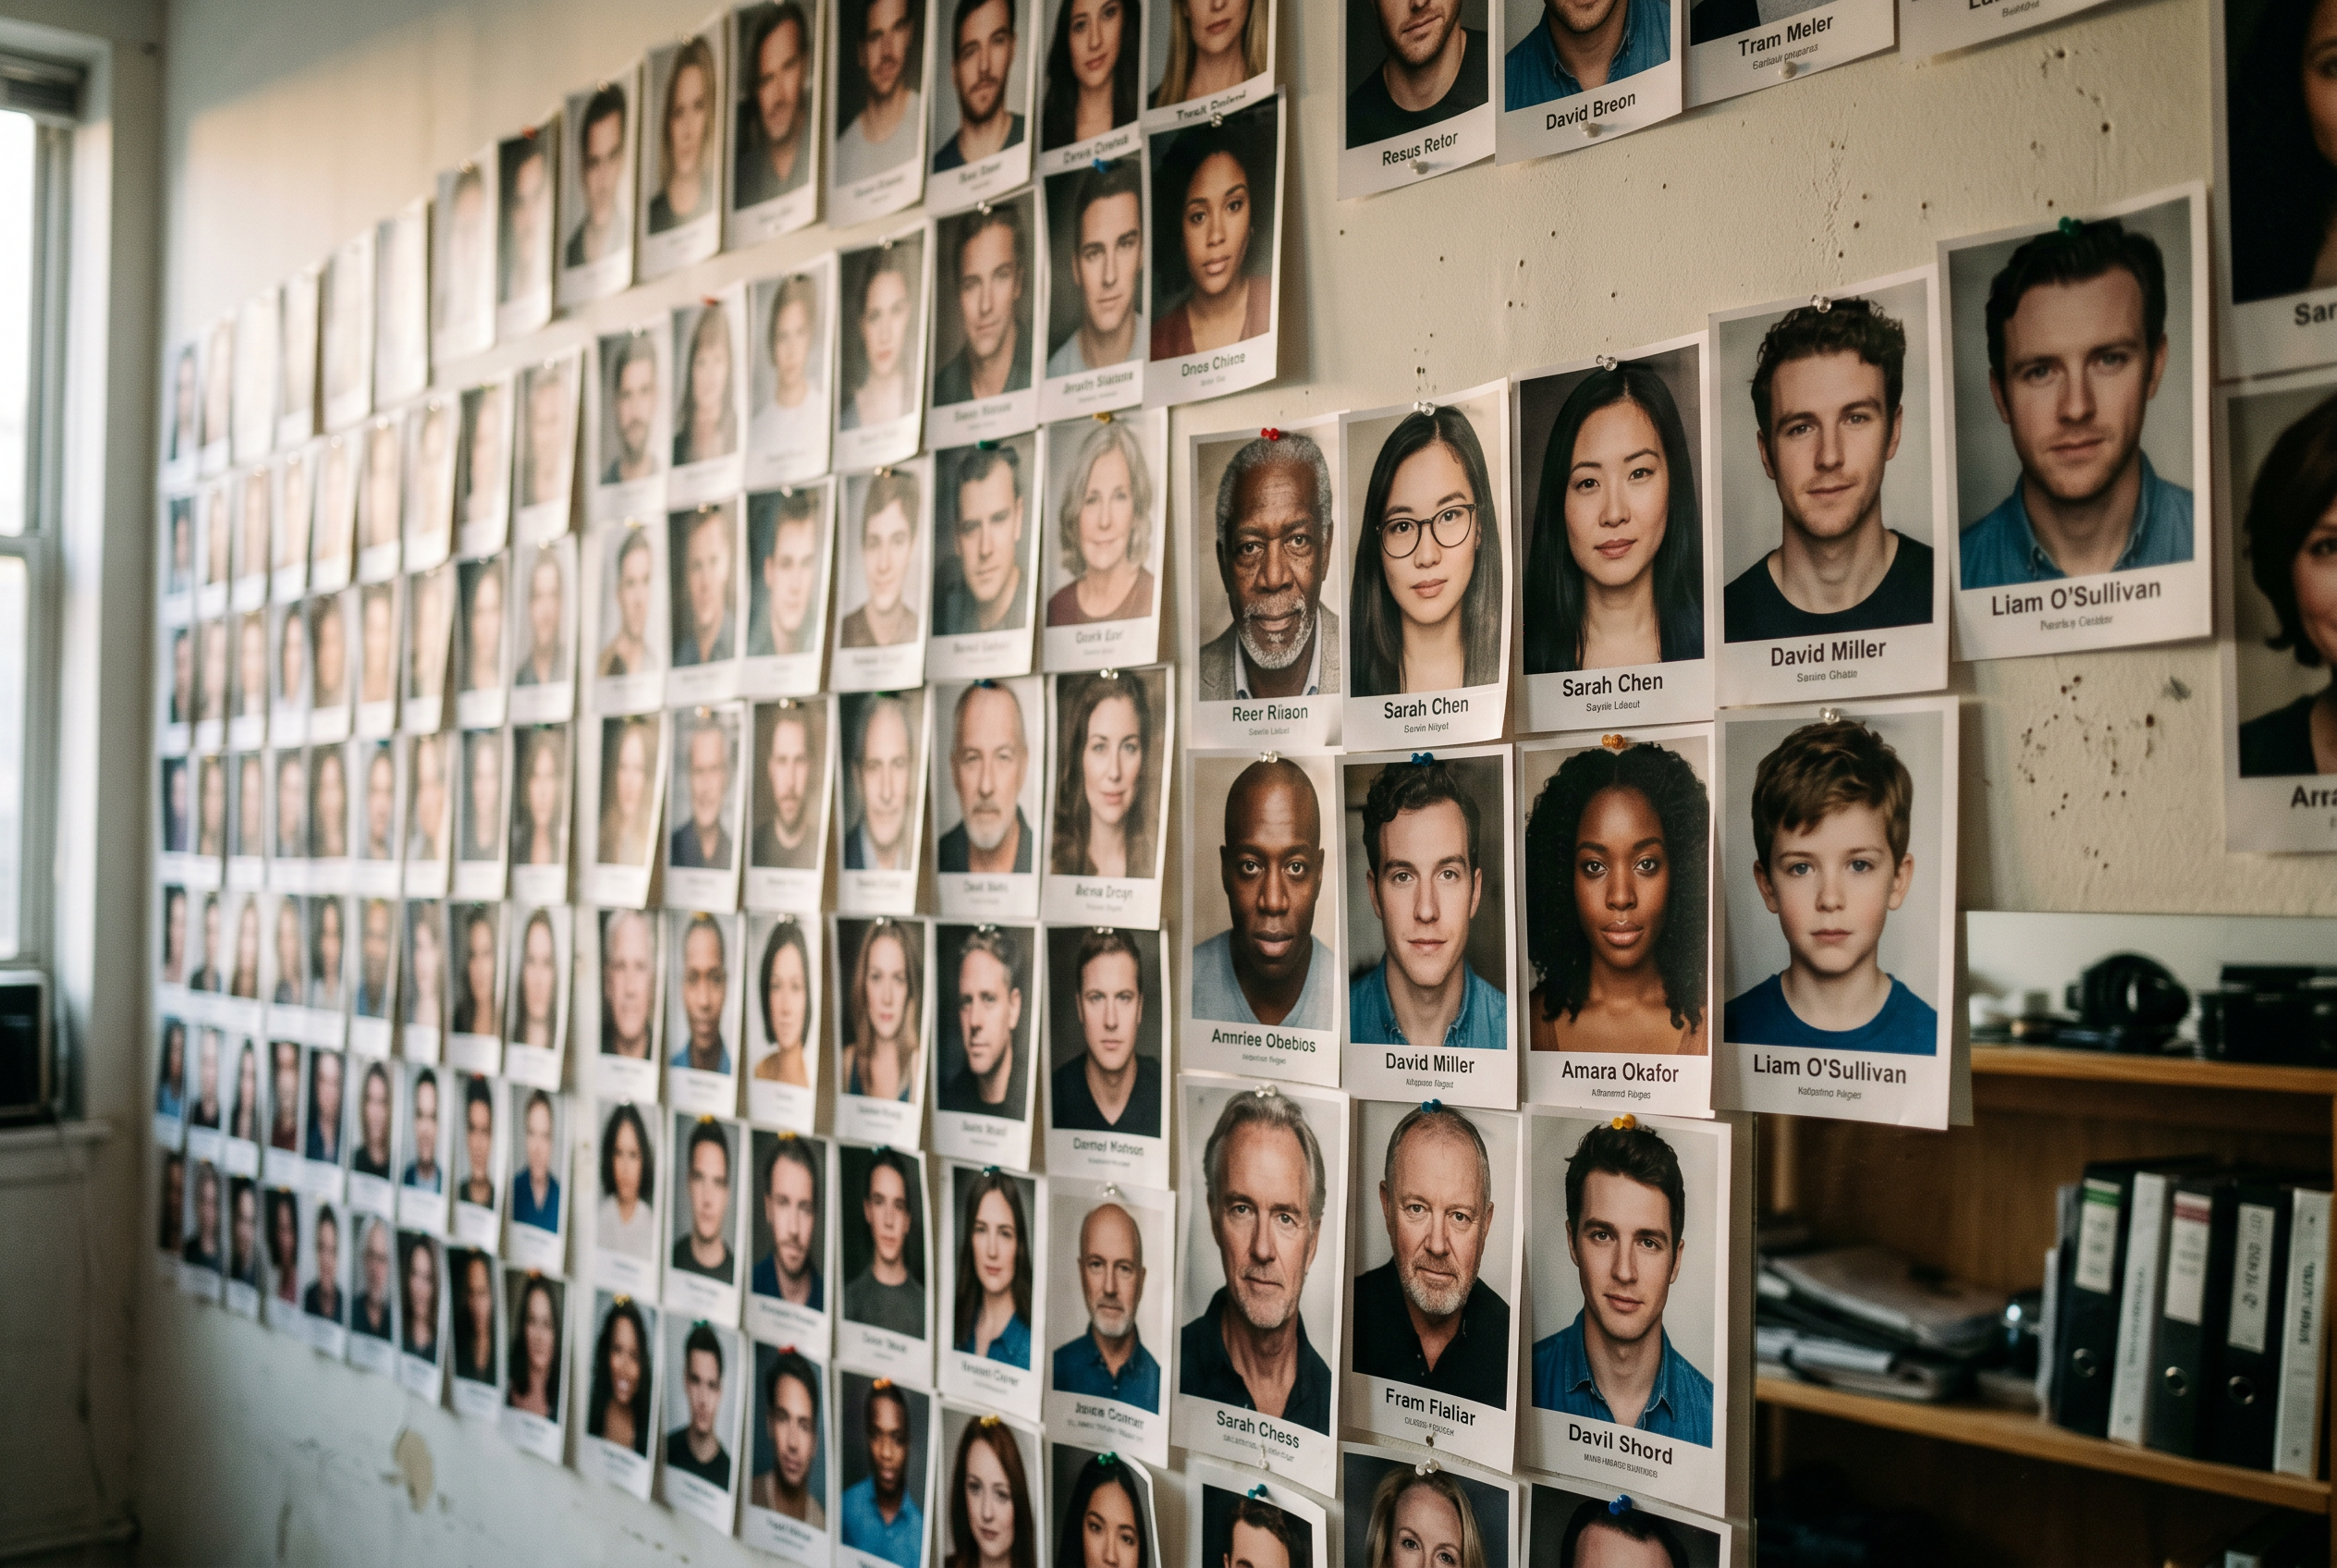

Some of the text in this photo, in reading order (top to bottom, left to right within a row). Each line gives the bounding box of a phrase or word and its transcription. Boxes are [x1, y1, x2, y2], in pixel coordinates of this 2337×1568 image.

[1738, 33, 1780, 56] Tram
[1787, 17, 1833, 43] Meler
[1547, 93, 1635, 130] David Breon
[1382, 133, 1458, 165] Resus Retor
[1992, 582, 2161, 616] Liam O'Sullivan
[1771, 639, 1887, 667] David Miller
[1562, 673, 1663, 697] Sarah Chen
[1232, 706, 1264, 721] Reer
[1384, 697, 1469, 718] Sarah Chen
[1266, 1034, 1315, 1052] Obebios
[1386, 1053, 1475, 1073] David Miller
[1561, 1060, 1679, 1083] Amara Okafor
[1754, 1054, 1906, 1084] Liam O'Sullivan
[1386, 1388, 1476, 1426] Fram Flaliar
[1217, 1411, 1255, 1434] Sarah
[1259, 1422, 1300, 1449] Chess
[1569, 1424, 1673, 1464] Davil Shord
